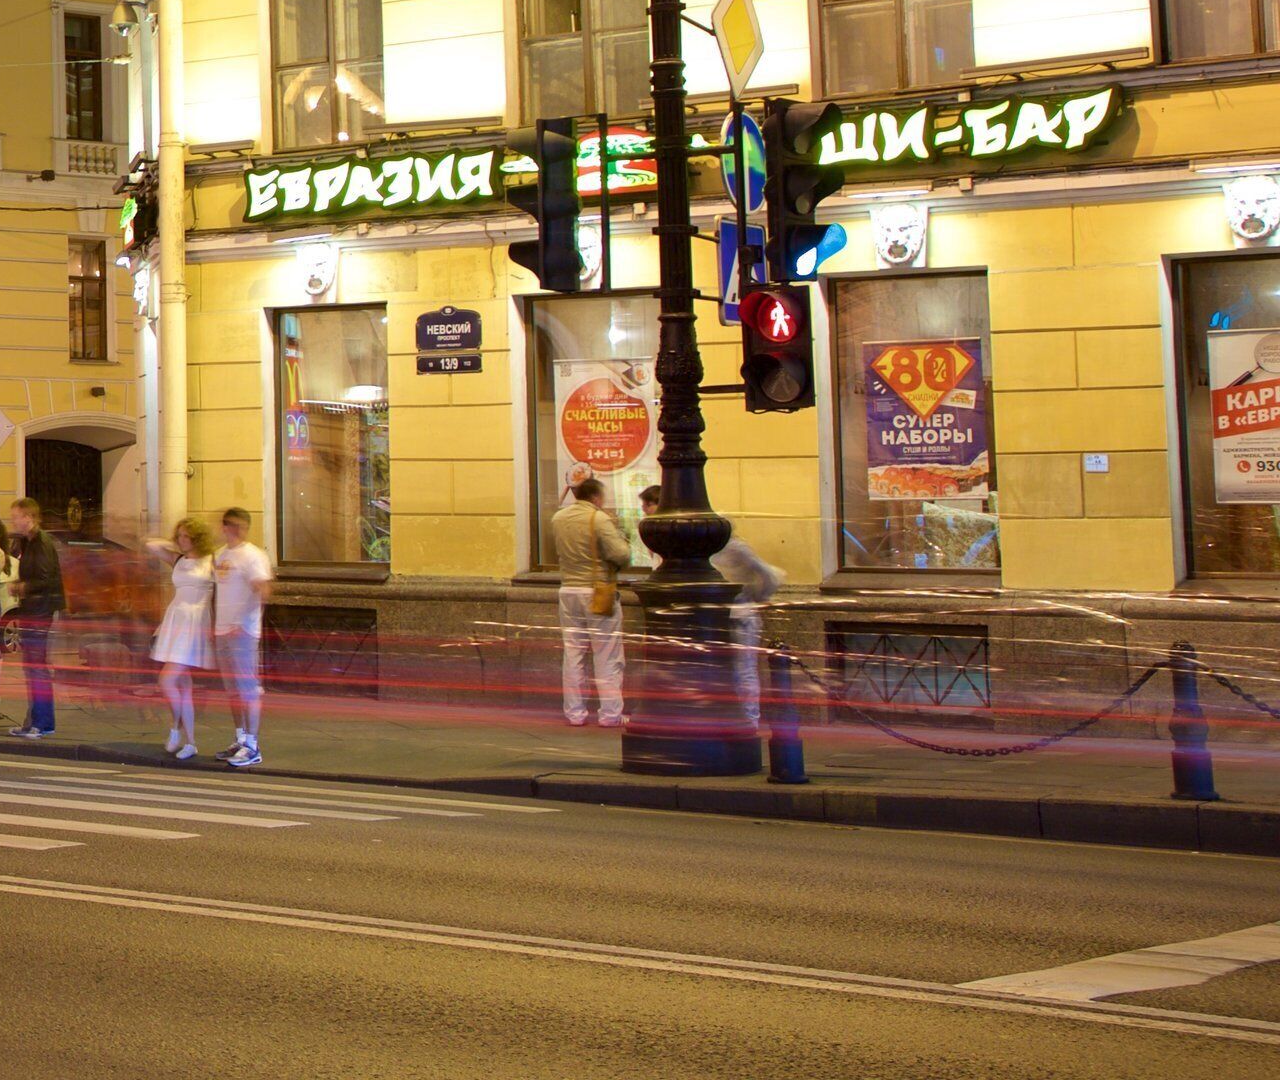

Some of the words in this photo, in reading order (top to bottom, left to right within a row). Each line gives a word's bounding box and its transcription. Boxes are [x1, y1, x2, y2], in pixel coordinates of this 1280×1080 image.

[248, 150, 494, 217] ЕВРАЗИЯ
[426, 321, 472, 336] НЕВСКИЙ
[440, 357, 459, 370] 13/9
[565, 407, 646, 421] СЧАСТЛИВЫЕ
[893, 413, 955, 429] СУПЕР
[587, 421, 623, 433] ЧАСЫ
[1218, 415, 1230, 429] В
[882, 428, 973, 445] НАБОРЫ
[587, 448, 625, 459] 1+1=1
